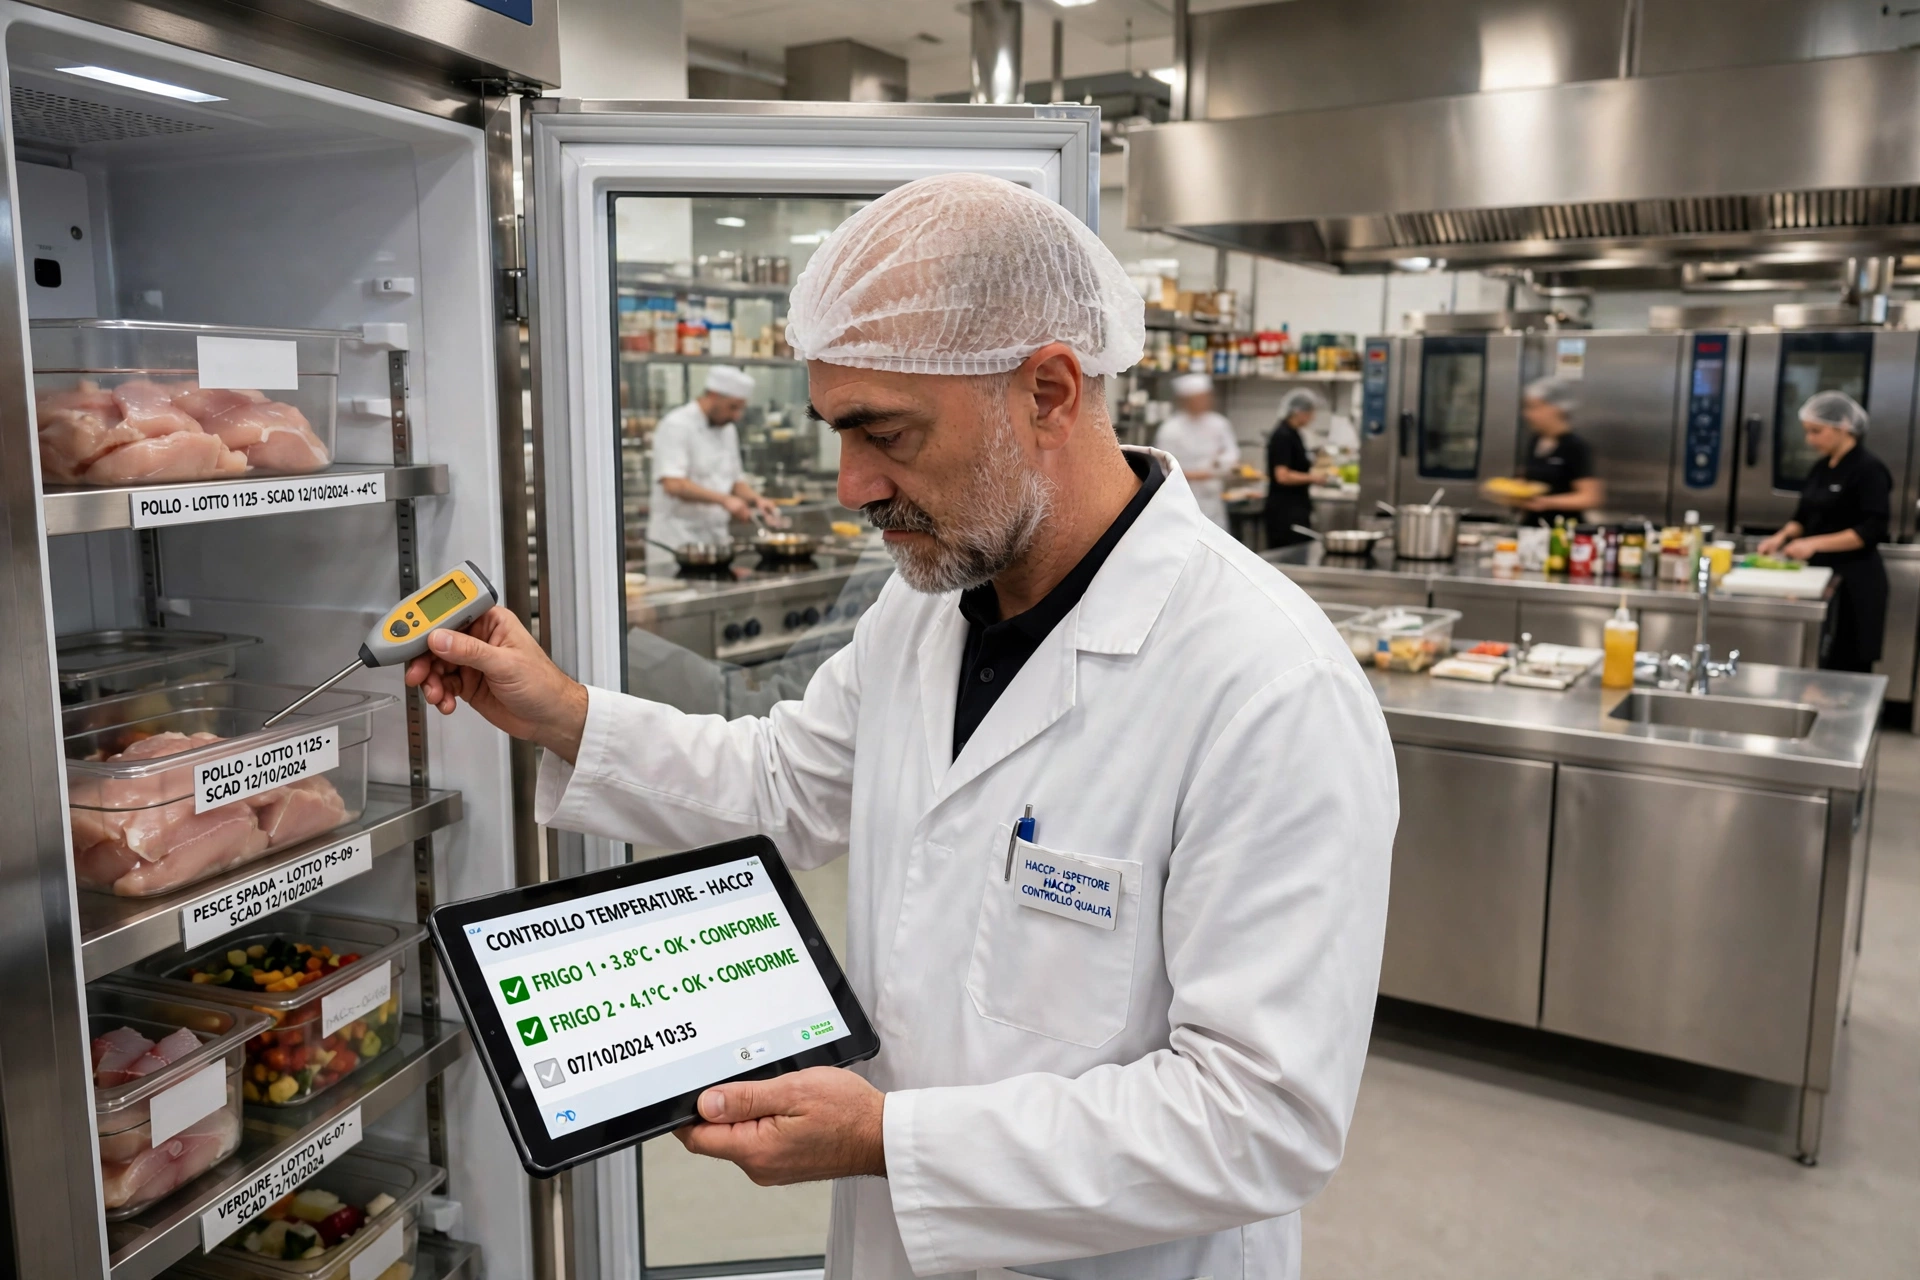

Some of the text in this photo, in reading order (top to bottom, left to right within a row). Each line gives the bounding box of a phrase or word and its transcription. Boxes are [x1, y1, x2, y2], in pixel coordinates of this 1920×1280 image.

[141, 498, 182, 515] POLLO
[192, 494, 229, 512] LOTTO
[232, 492, 258, 508] 1125
[267, 488, 295, 504] SCAD
[297, 484, 349, 502] 12/10/2024
[202, 759, 244, 785] POLLO
[255, 745, 293, 768] LOTTO
[296, 736, 322, 756] 1125
[206, 759, 307, 803] SCAD 12/10/2024
[193, 895, 233, 923] PESCE
[237, 877, 276, 906] SPADA
[286, 859, 322, 884] LOTTO
[325, 846, 353, 868] PS-09
[230, 875, 323, 926] SCAD 12/10/2024
[1021, 884, 1112, 919] CONTROLLO QUALITÀ
[1025, 859, 1056, 875] HACCP
[1062, 870, 1110, 892] ISPETTORE
[486, 913, 585, 951] CONTROLLO
[585, 885, 698, 926] TEMPERATURE
[706, 871, 754, 896] HACCP
[531, 965, 583, 992] FRIGO
[585, 960, 597, 977] 1
[663, 935, 689, 955] OK
[699, 912, 780, 945] CONFORME
[549, 1004, 600, 1033] FRIGO
[602, 1000, 616, 1018] 2
[681, 973, 707, 993] OK
[717, 947, 799, 983] CONFORME
[567, 1021, 697, 1075] 07/10/2024 10:35
[217, 1173, 272, 1219] VERDURE
[281, 1144, 315, 1176] LOTTO
[316, 1122, 346, 1150] VG-07
[237, 1153, 324, 1224] SCAD 12/10/2024
